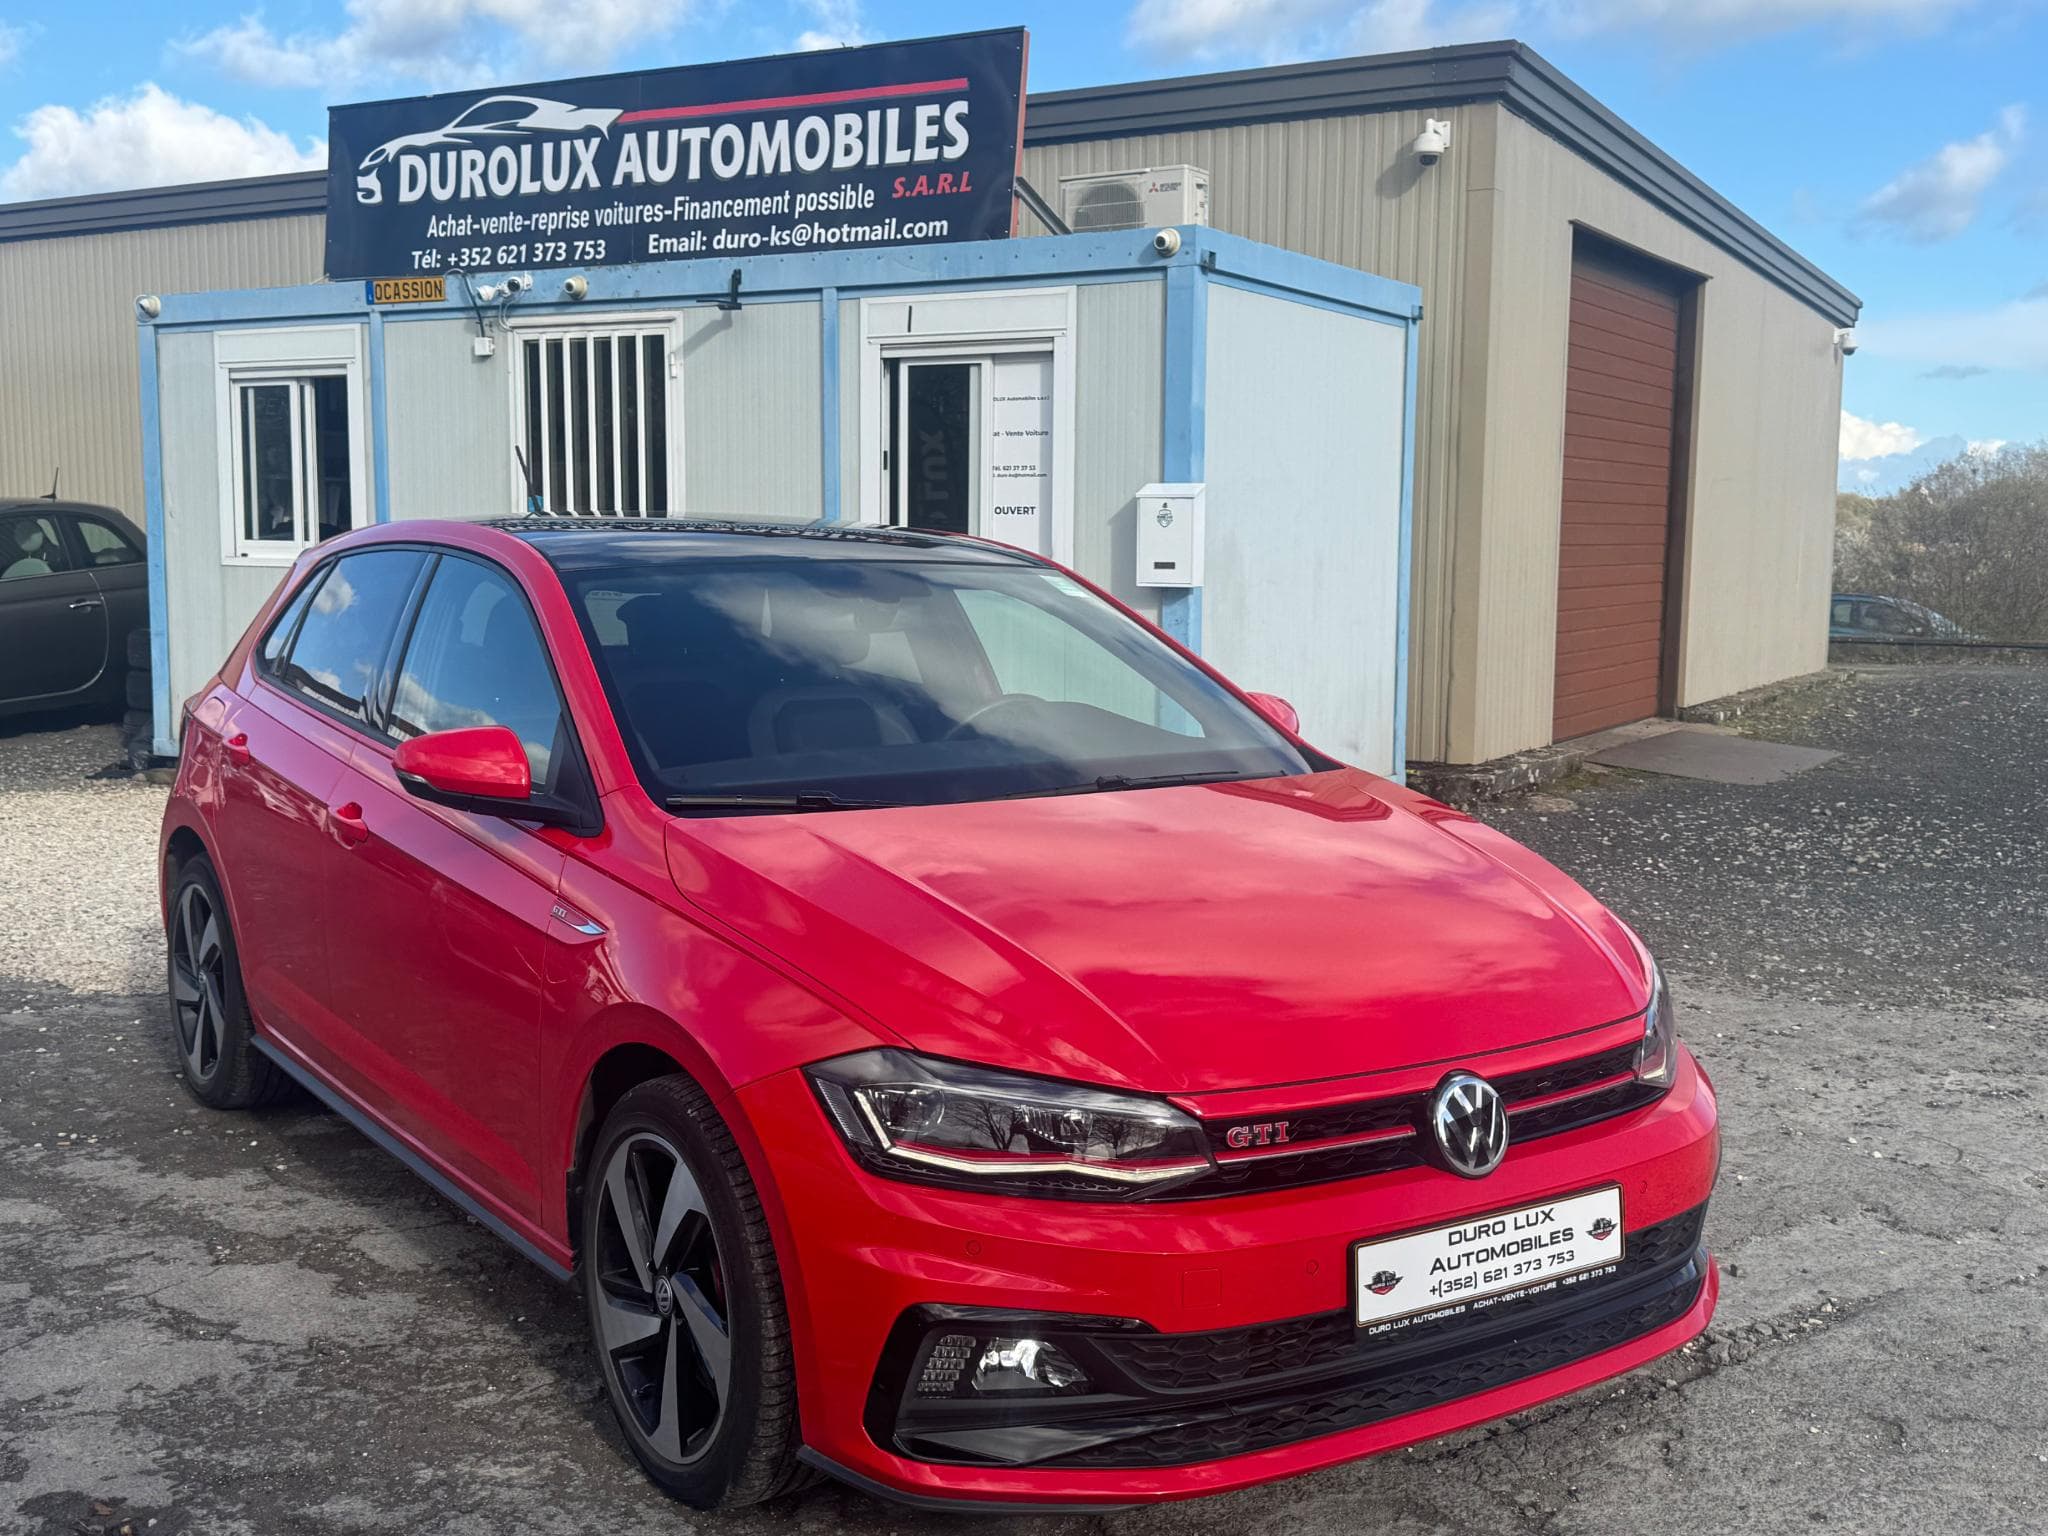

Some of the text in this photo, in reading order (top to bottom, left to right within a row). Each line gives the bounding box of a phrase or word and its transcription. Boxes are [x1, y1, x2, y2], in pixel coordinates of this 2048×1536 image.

[399, 100, 970, 202] DUROLUX AUTOMOBILES
[892, 171, 972, 198] S.A.R.L
[427, 183, 875, 238] Achat-vente-reprise voitures-Financement possible
[411, 239, 606, 269] Tél: +352 621 373 753
[648, 218, 948, 254] Email: duro-ks@hotmail.com
[374, 280, 443, 300] OCASSION
[994, 506, 1036, 515] OUVERT
[1227, 1121, 1289, 1148] GTI
[1448, 1207, 1556, 1247] DURO LUX
[1429, 1227, 1575, 1276] AUTOMOBILES
[1429, 1250, 1575, 1298] +(352) 621 373 753
[1368, 1323, 1391, 1335] DURO
[1393, 1318, 1411, 1329] LUX
[1412, 1305, 1466, 1324] AUTOMOBILES
[1472, 1281, 1557, 1310] ACHAT-VENTE-VOITURE
